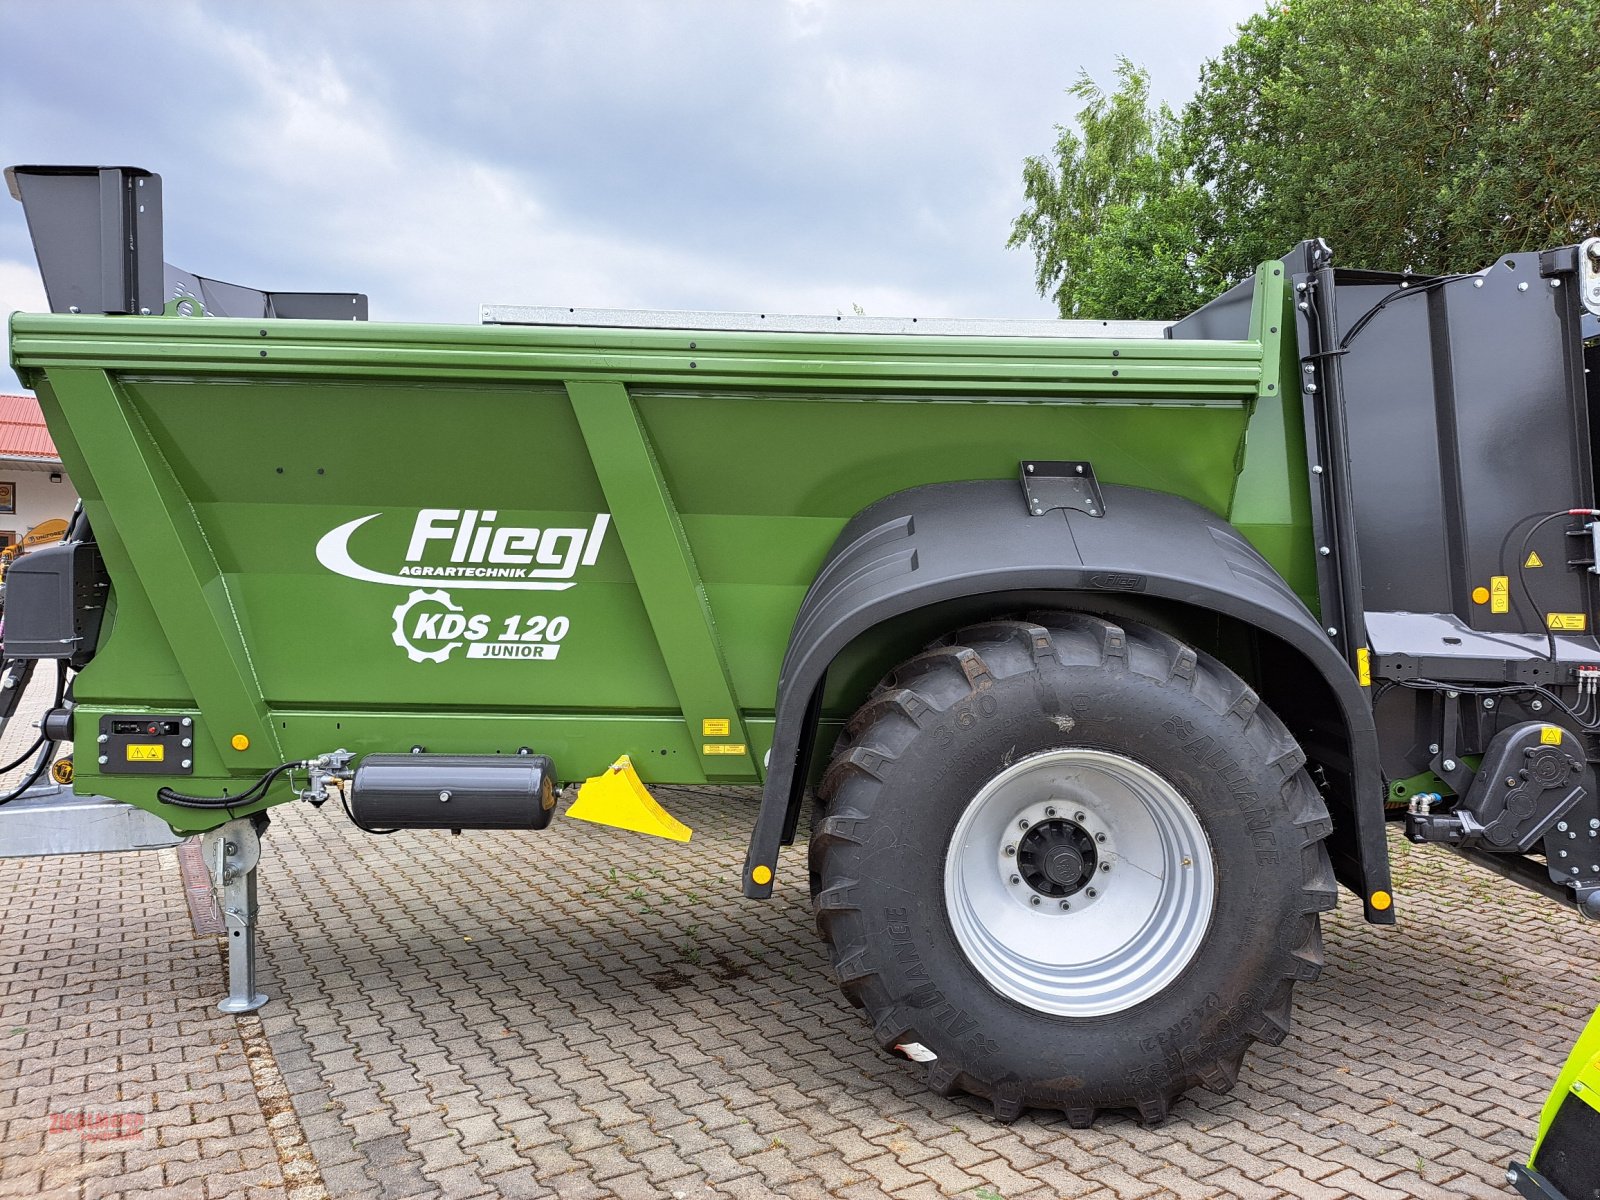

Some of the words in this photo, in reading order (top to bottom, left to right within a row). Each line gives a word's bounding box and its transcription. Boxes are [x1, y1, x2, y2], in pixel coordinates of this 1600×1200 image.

[405, 508, 610, 579] Fliegl
[399, 566, 528, 579] AGRARTECHNIK
[413, 613, 491, 640] KDS
[498, 615, 570, 643] 120
[483, 645, 545, 658] JUNIOR
[1182, 735, 1280, 867] ALLIANCE
[884, 906, 982, 1038] ALLIANCE
